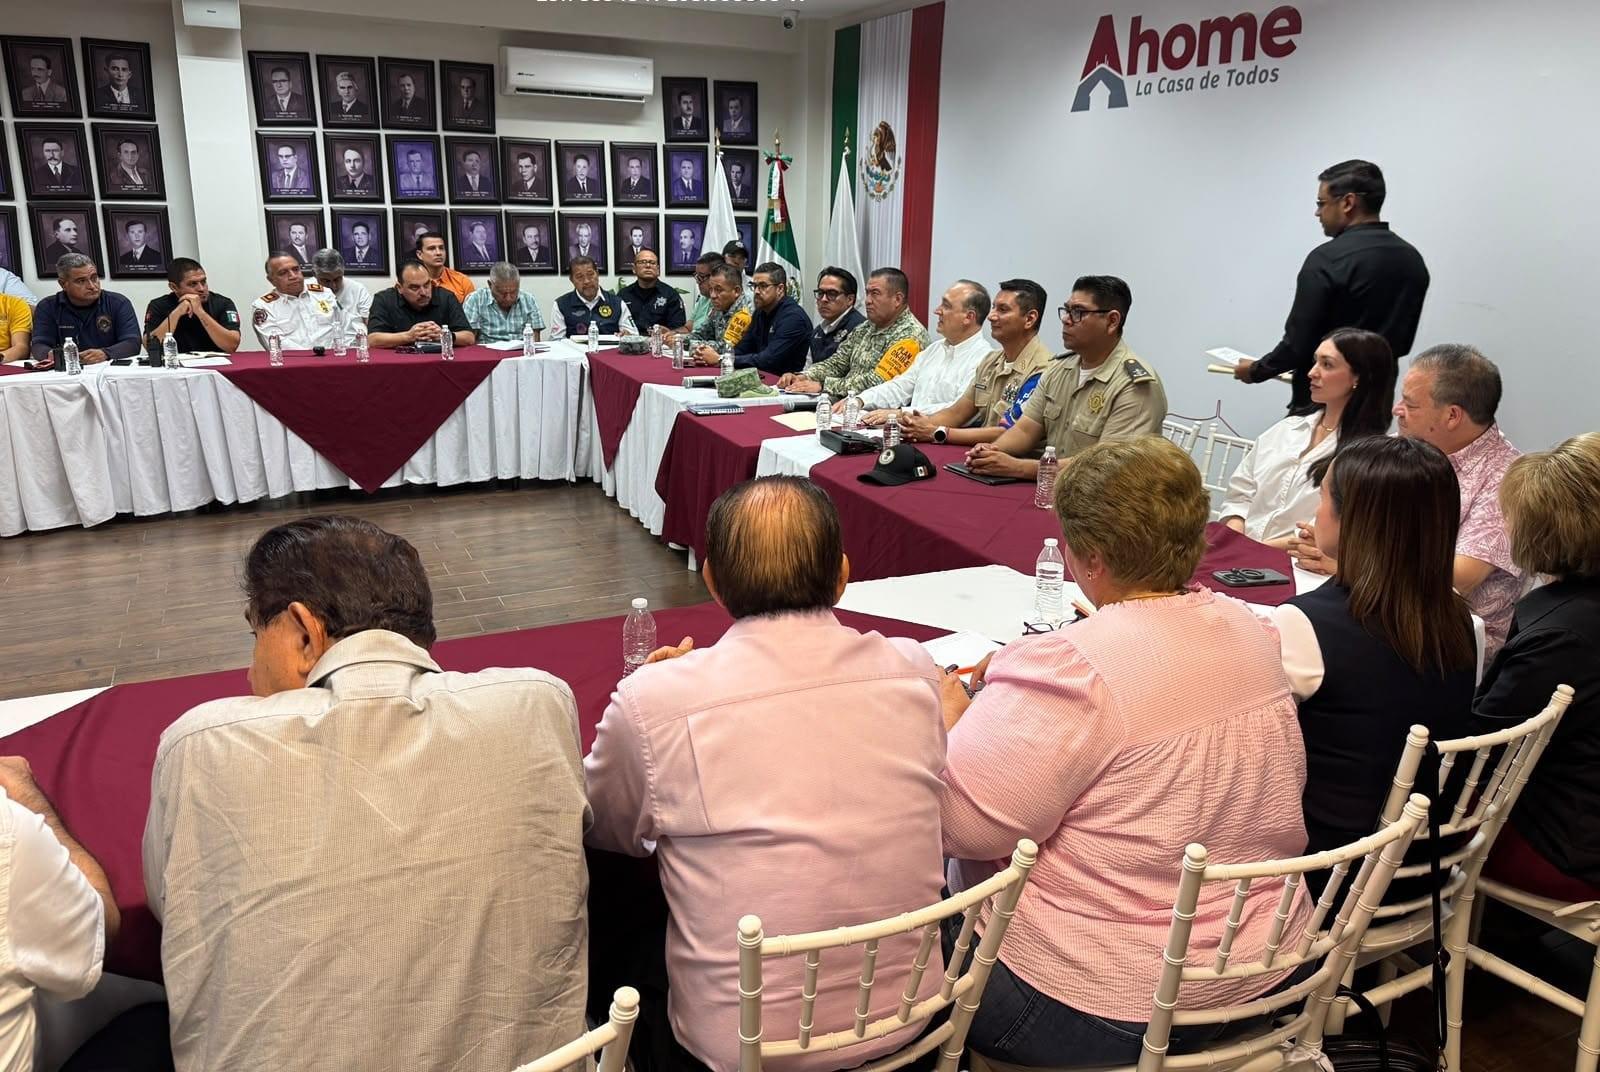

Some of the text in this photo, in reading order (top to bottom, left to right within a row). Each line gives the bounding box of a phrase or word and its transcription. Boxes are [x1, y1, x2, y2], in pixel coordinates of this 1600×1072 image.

[1070, 5, 1303, 112] Ahome
[1135, 64, 1280, 97] La Casa de Todos
